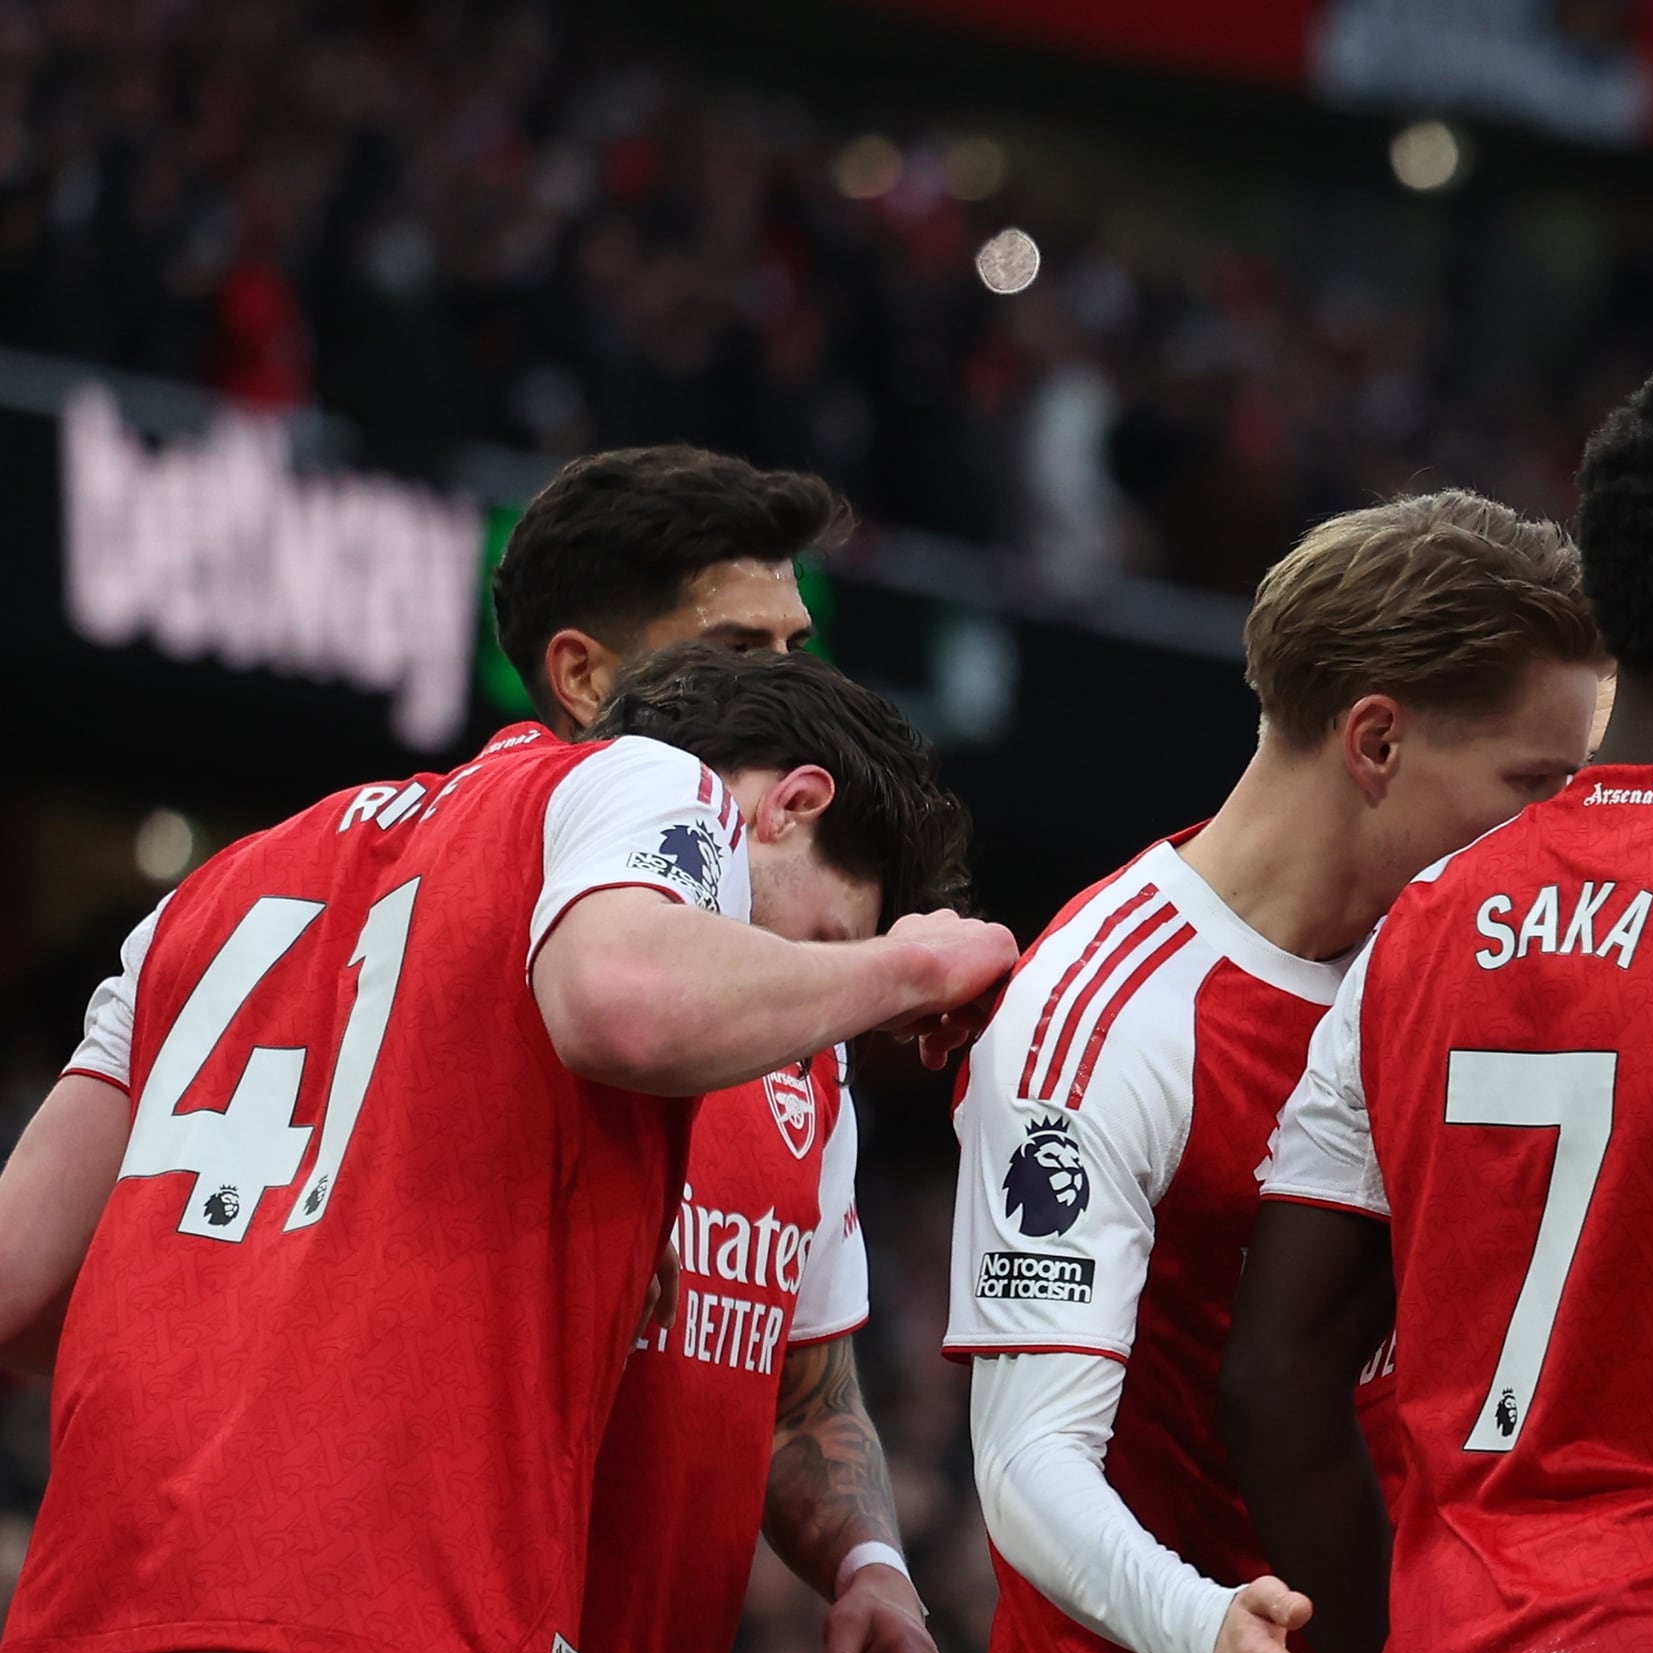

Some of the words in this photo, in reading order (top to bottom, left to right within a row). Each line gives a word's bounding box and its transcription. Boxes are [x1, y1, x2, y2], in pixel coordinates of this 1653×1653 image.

[116, 874, 422, 1244] 41
[976, 1274, 1006, 1298] for
[1010, 1278, 1092, 1303] racism
[981, 1253, 1010, 1277] No
[1013, 1257, 1082, 1282] room
[1444, 1048, 1618, 1453] 7
[683, 1288, 784, 1376] BETTER
